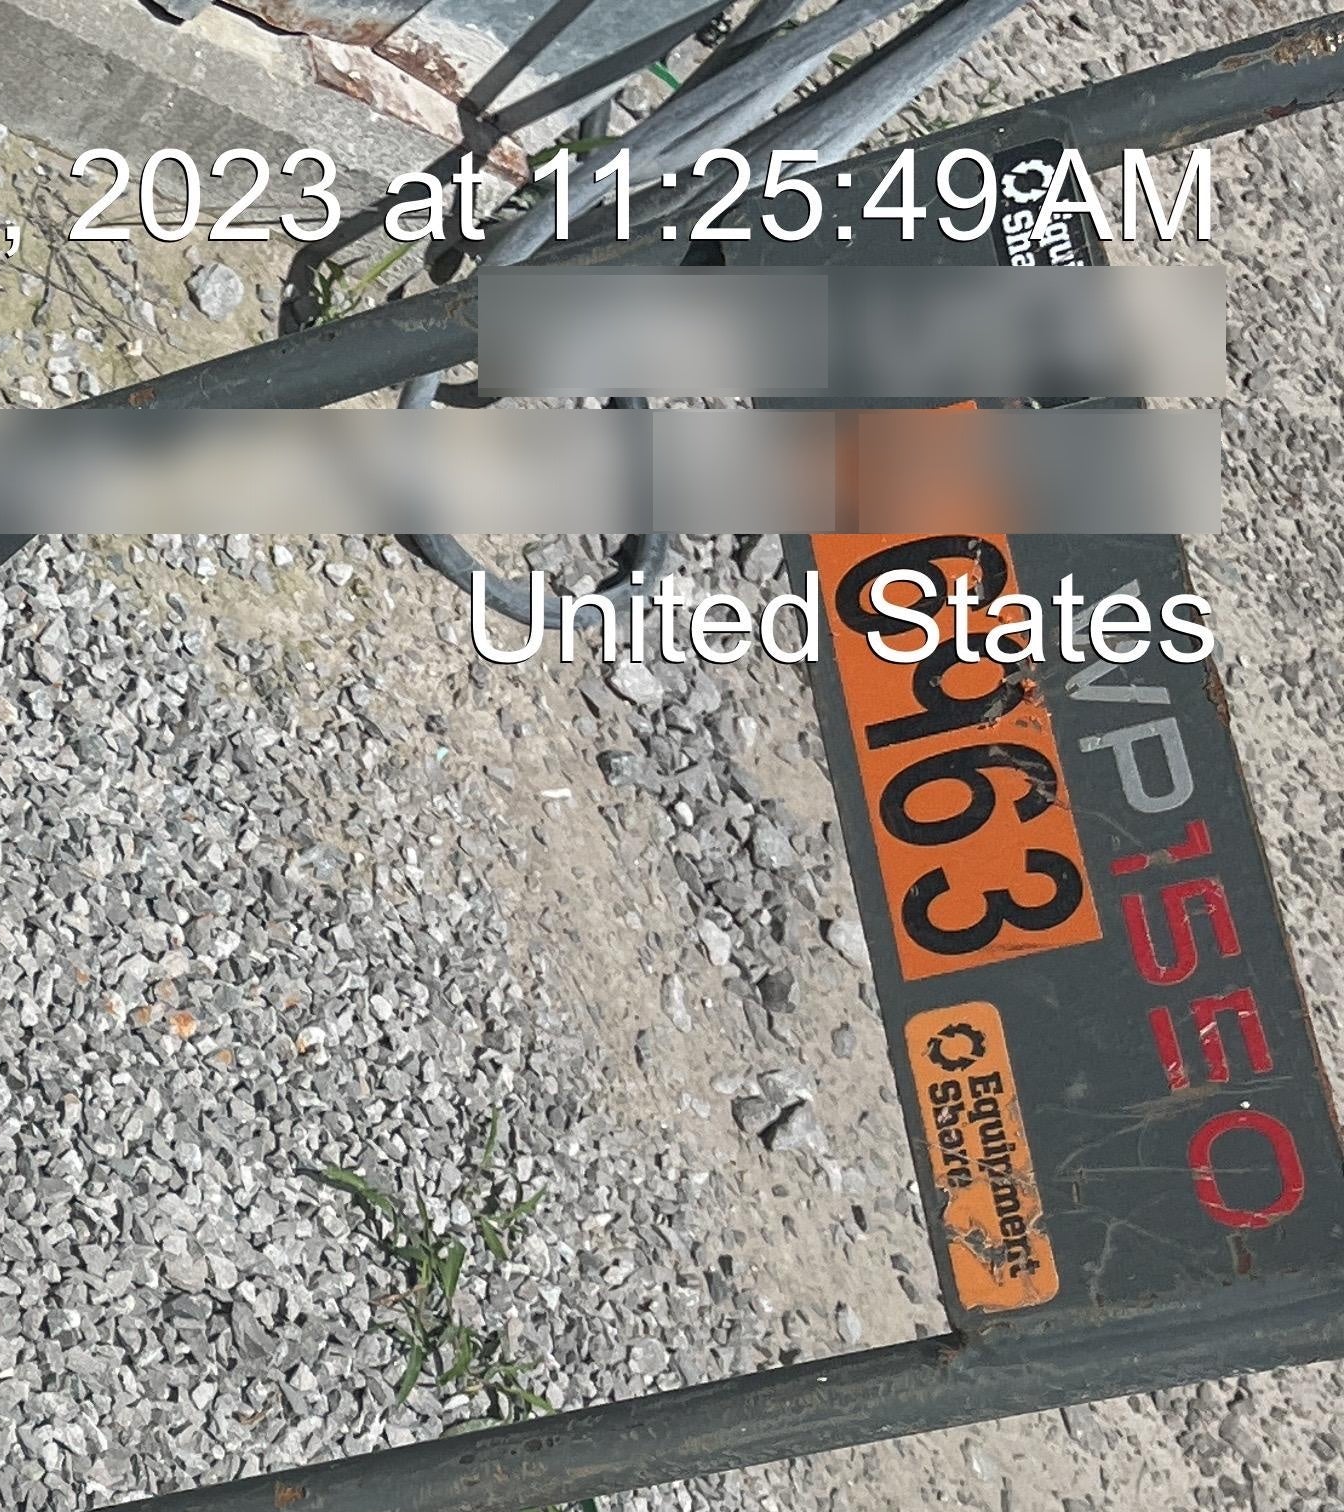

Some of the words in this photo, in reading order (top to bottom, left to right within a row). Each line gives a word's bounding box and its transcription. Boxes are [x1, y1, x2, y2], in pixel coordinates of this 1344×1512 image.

[835, 535, 1083, 957] 6963
[928, 1080, 973, 1190] Share
[968, 1071, 1041, 1279] Equipment
